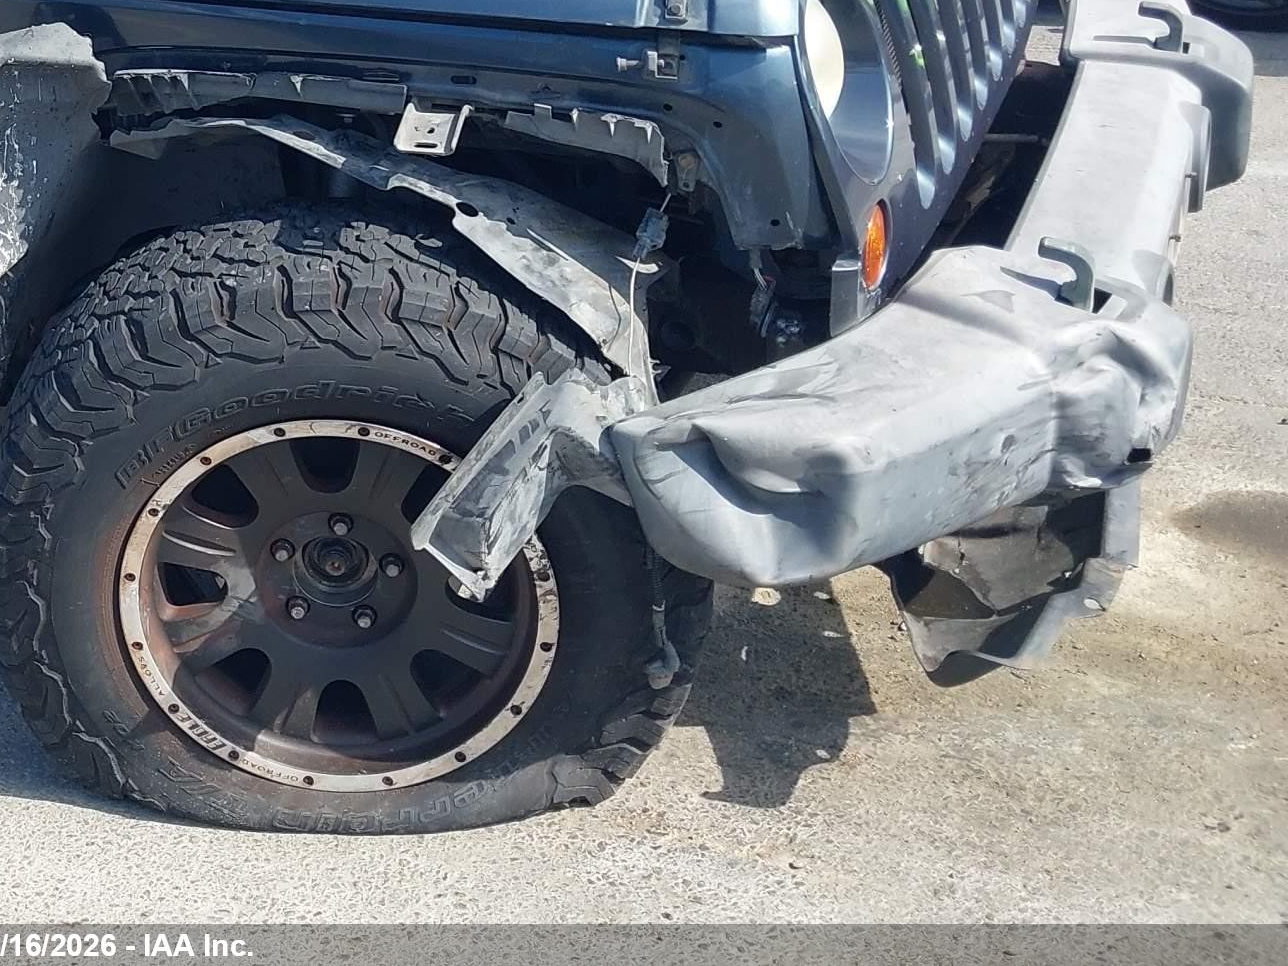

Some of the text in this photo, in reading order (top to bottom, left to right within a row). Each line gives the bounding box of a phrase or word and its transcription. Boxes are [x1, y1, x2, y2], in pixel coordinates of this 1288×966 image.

[374, 430, 437, 457] OFFROAD
[138, 656, 165, 697] ALLOYS
[240, 758, 300, 782] OFFROAD
